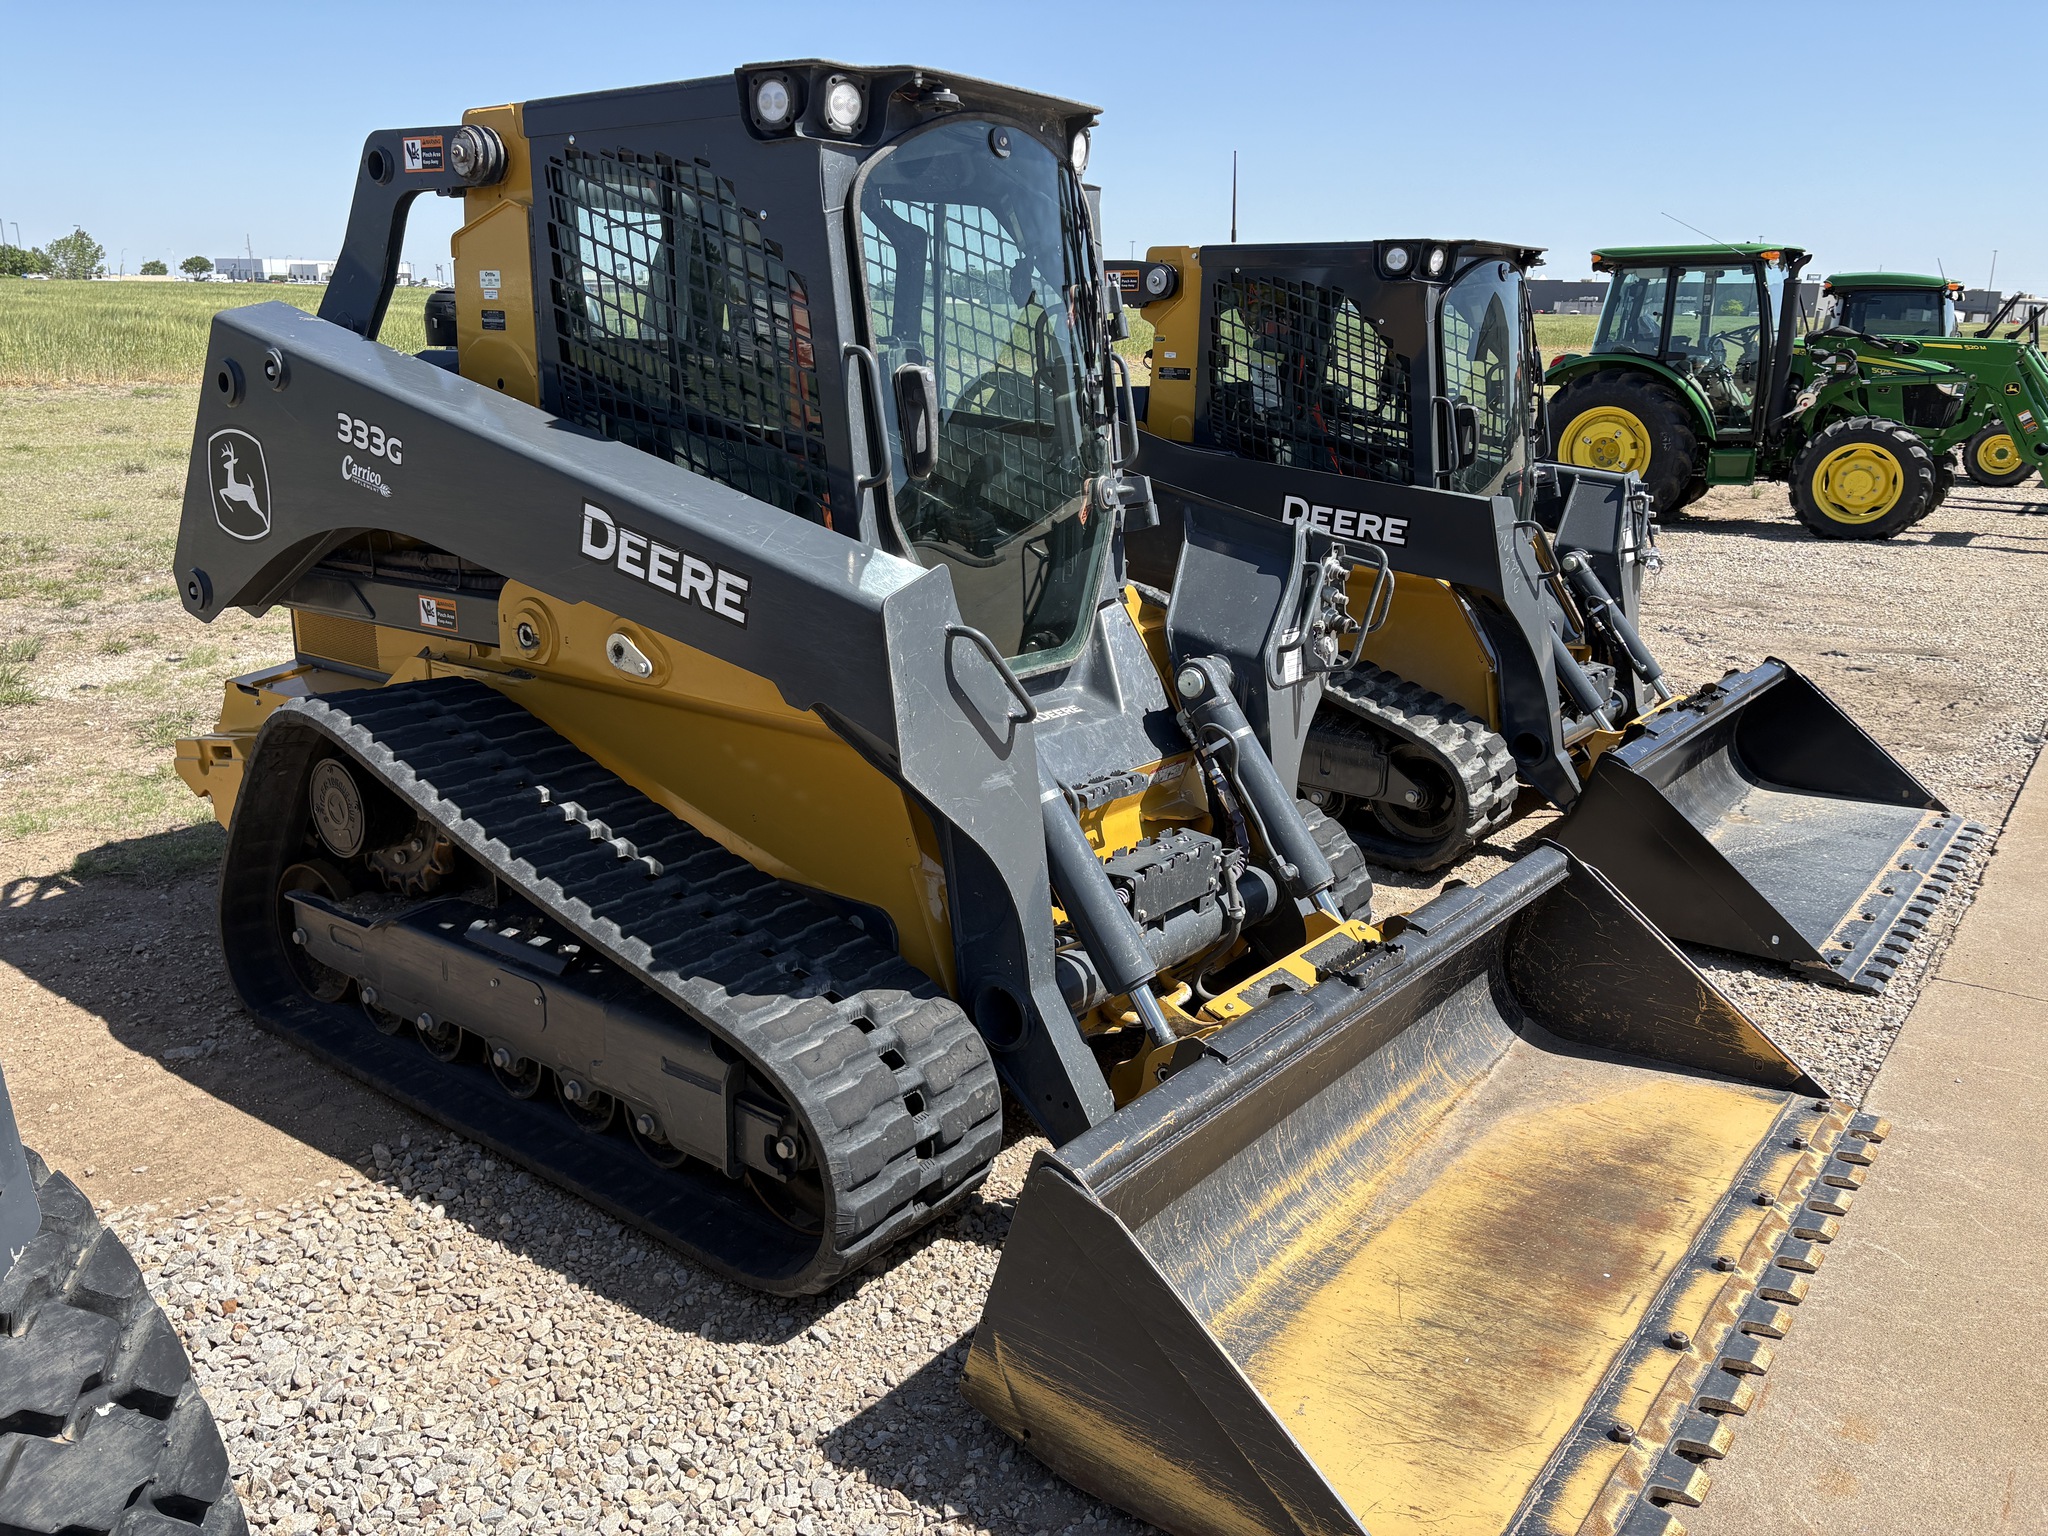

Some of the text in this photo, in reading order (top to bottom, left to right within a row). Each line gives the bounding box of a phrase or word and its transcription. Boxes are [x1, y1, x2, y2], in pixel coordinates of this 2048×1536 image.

[337, 412, 402, 465] 333G
[342, 454, 382, 486] Carrico
[351, 478, 380, 493] IMPLEMENT
[1282, 495, 1409, 546] DEERE
[581, 502, 750, 625] DEERE
